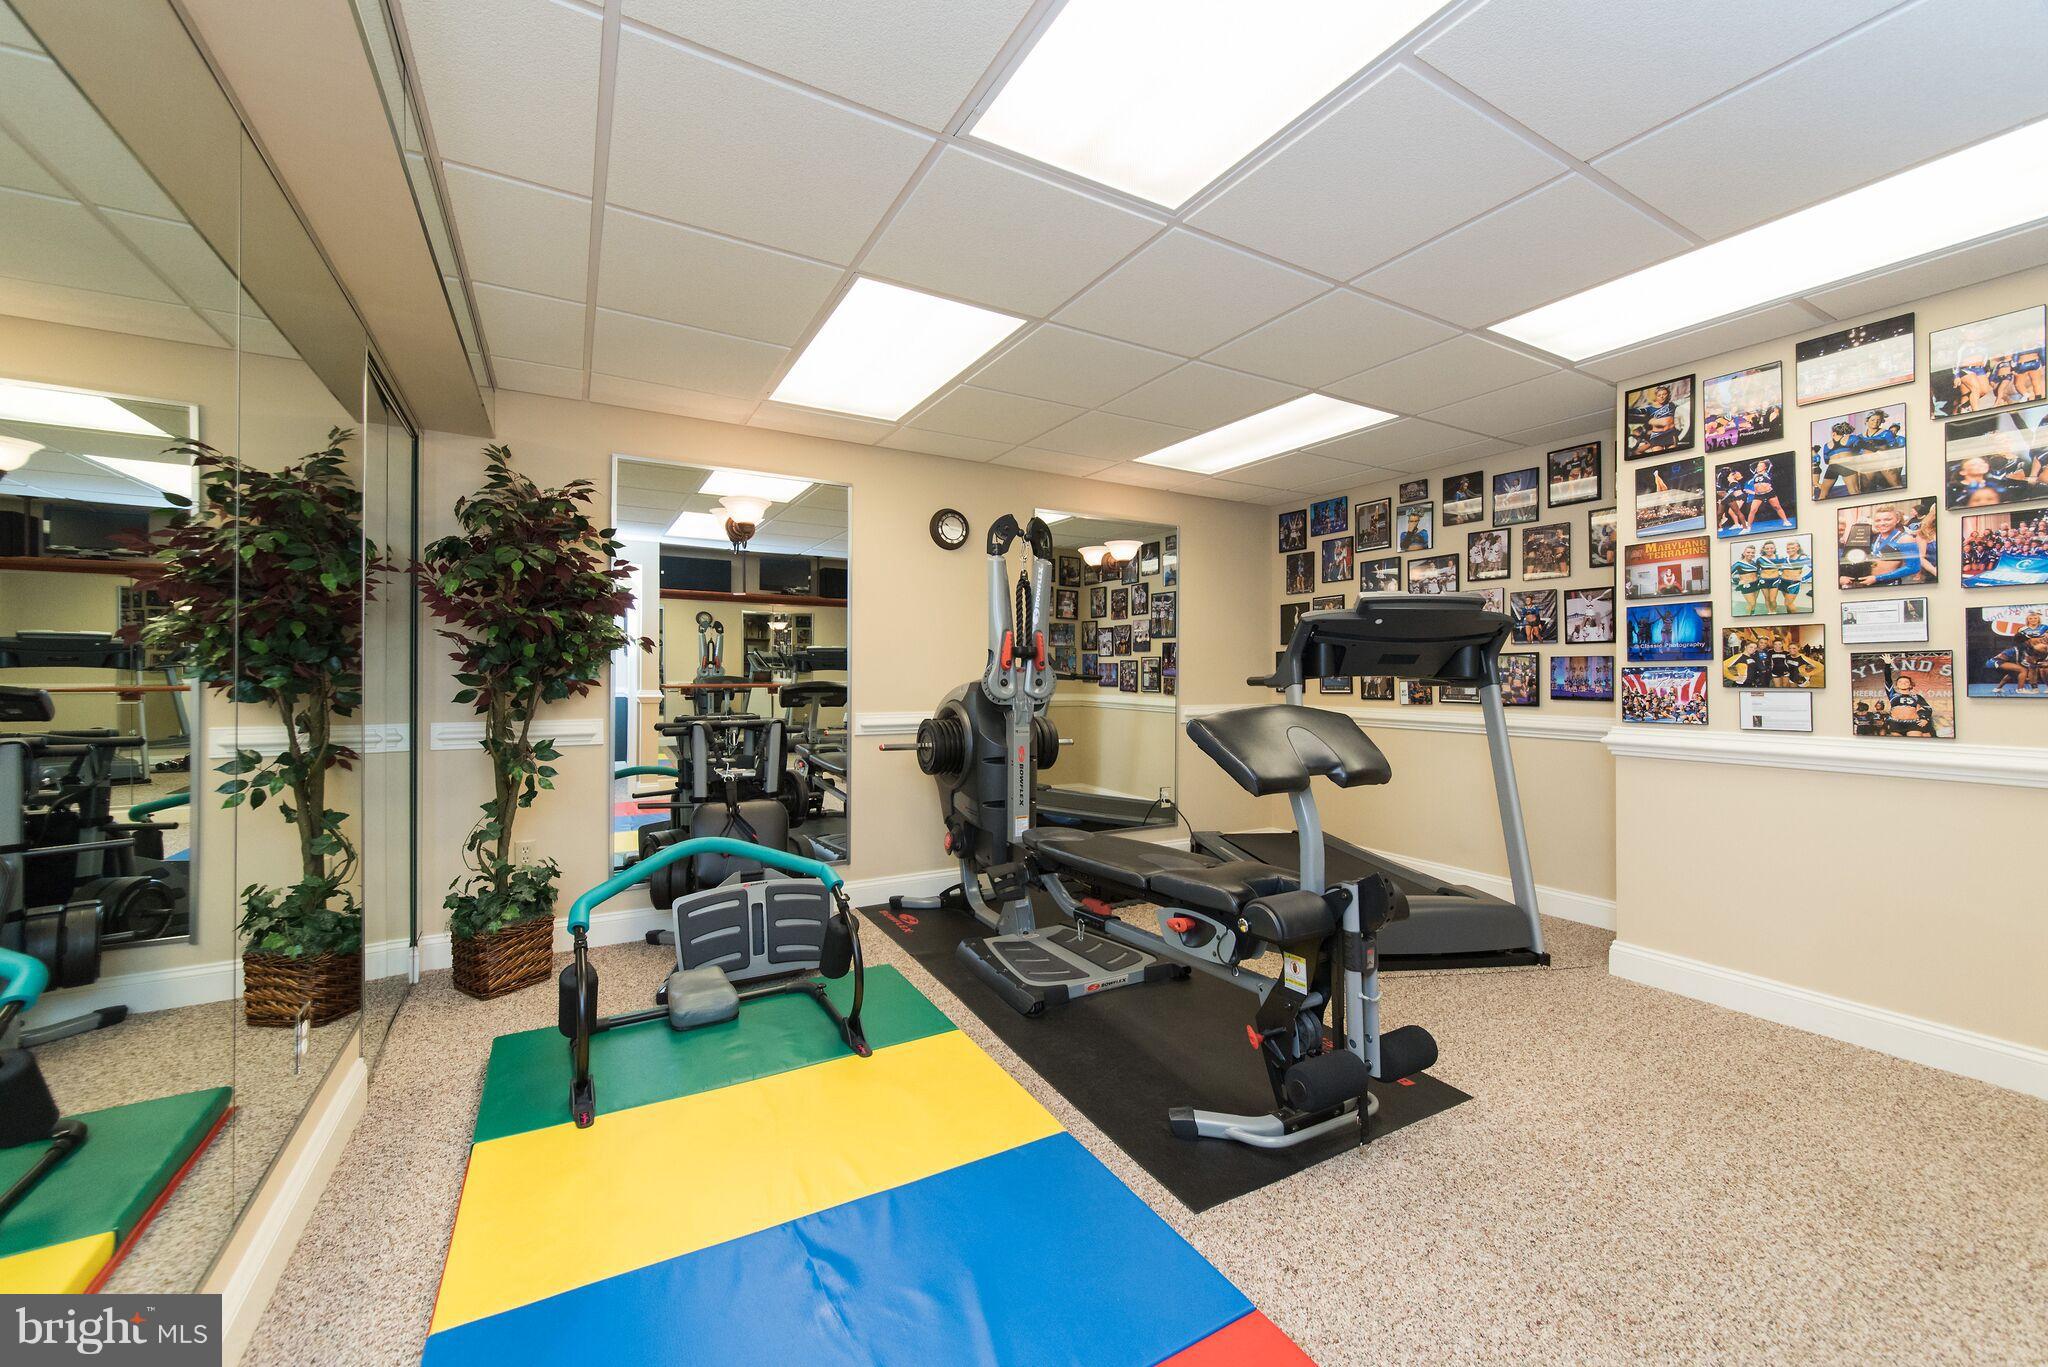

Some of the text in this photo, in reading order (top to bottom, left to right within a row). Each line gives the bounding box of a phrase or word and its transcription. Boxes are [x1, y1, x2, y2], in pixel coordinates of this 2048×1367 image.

[1645, 539, 1707, 554] MARYLAND
[1646, 546, 1707, 560] TERRAPINS
[1034, 564, 1044, 609] BOWFLEX
[1664, 641, 1706, 649] Photography
[1100, 977, 1127, 988] BOWFLEX
